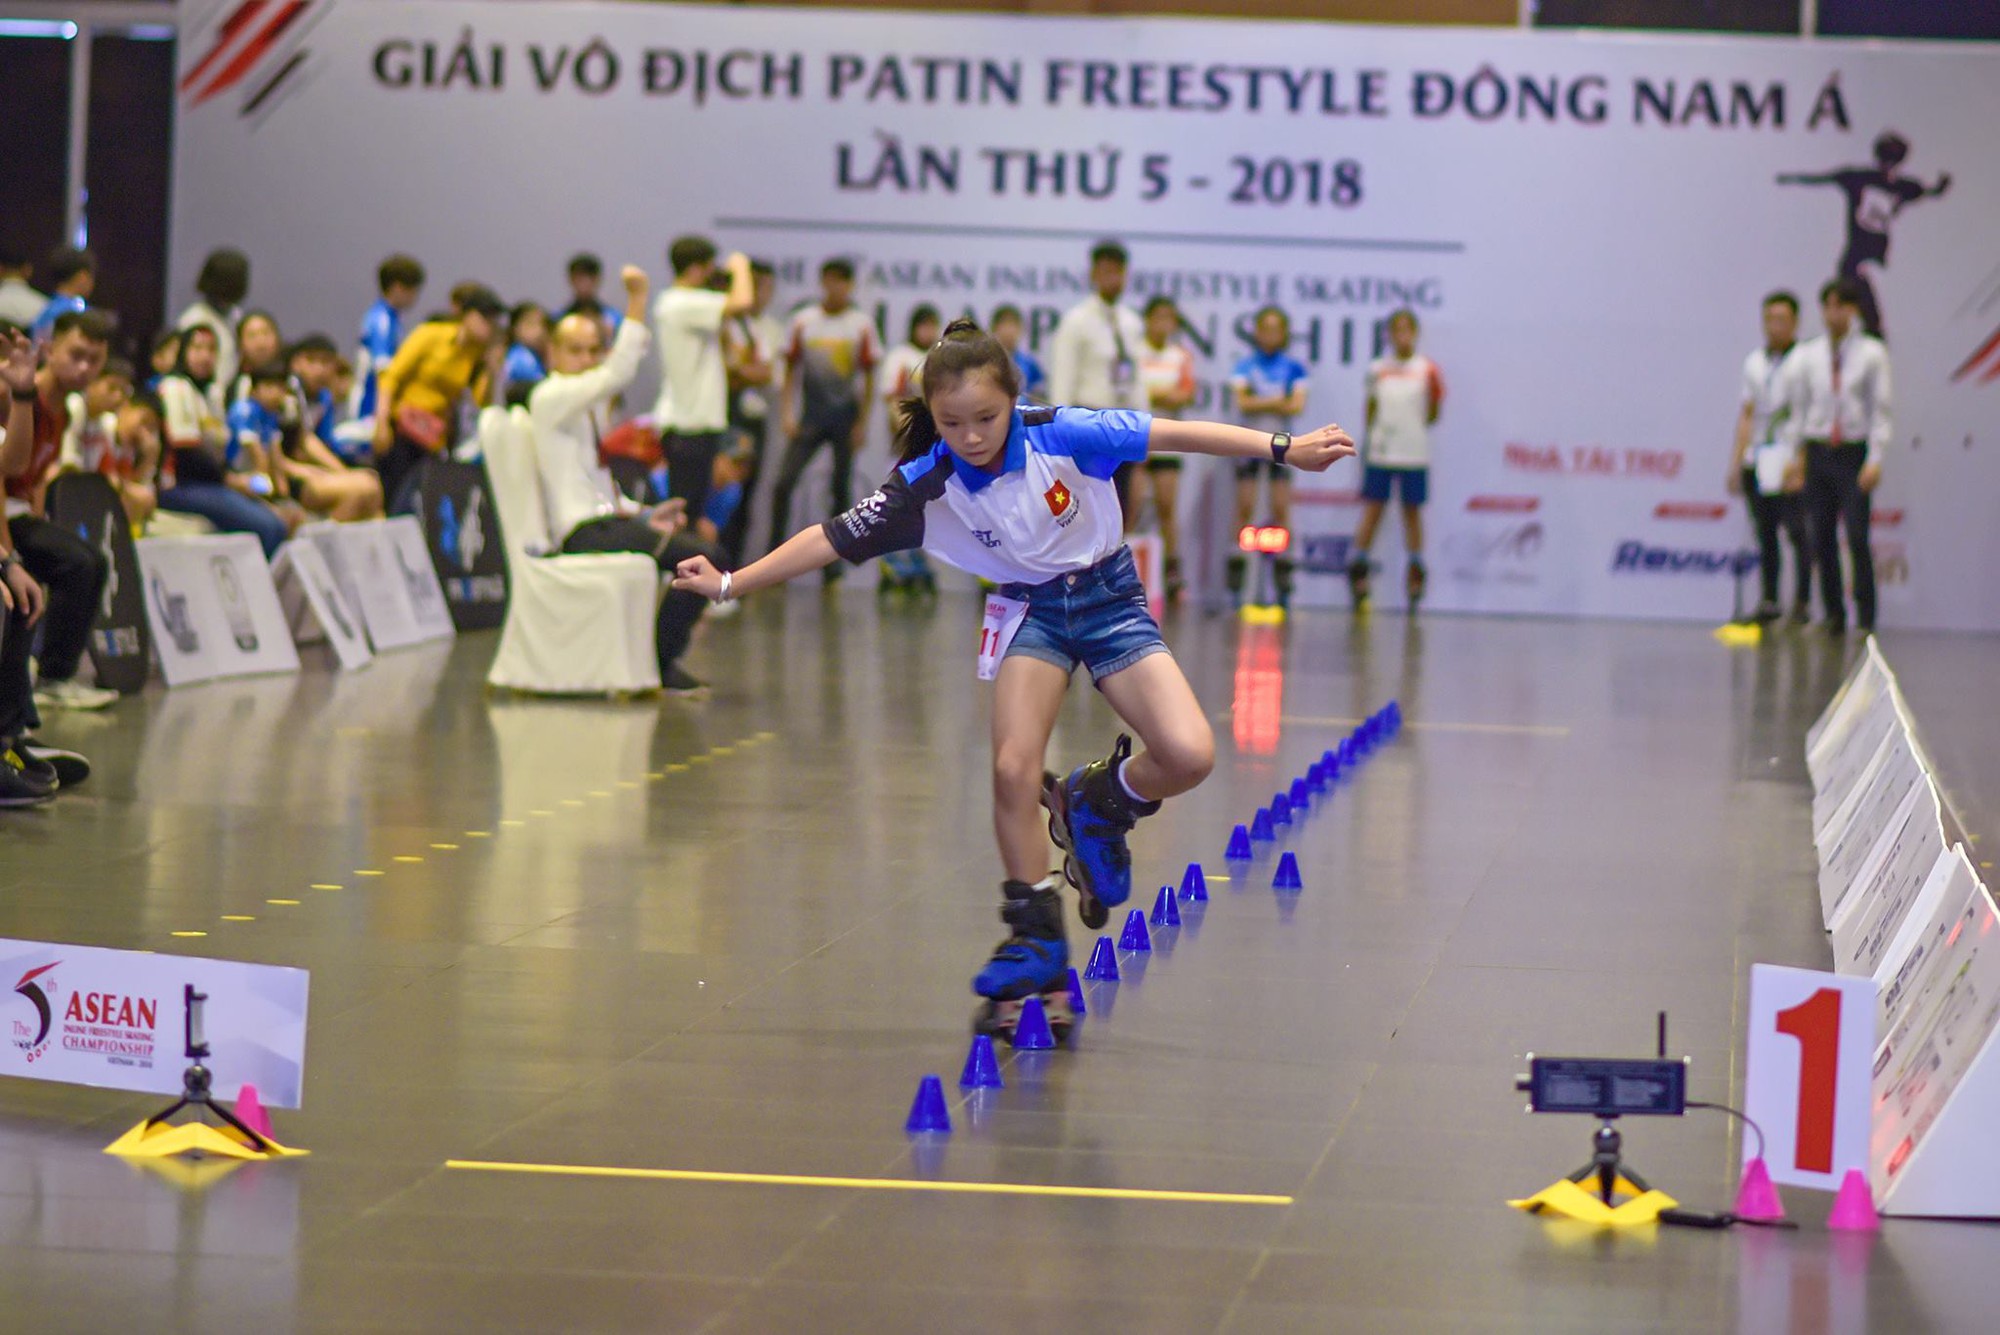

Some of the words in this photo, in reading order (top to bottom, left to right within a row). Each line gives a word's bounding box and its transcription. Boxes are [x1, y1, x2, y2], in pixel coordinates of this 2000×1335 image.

[372, 26, 503, 90] GIẢI
[526, 38, 621, 94] VÔ
[642, 50, 801, 108] ĐỊCH
[828, 54, 1022, 107] PATIN
[1046, 59, 1389, 117] FREESTYLE
[1410, 64, 1607, 124] ĐÔNG
[1632, 77, 1786, 128] NAM
[1805, 72, 1851, 131] Á
[836, 130, 959, 192] LẦN
[978, 144, 1121, 199] THỨ
[1140, 154, 1170, 198] 5
[1229, 156, 1364, 207] 2018
[870, 261, 976, 288] ASEAN
[987, 264, 1087, 292] INLIN
[1130, 270, 1285, 301] REESTYLE
[1295, 275, 1443, 307] SKATING
[979, 627, 1001, 657] 11
[47, 977, 58, 993] th
[13, 1021, 32, 1037] The
[65, 990, 157, 1030] ASEAN
[62, 1035, 155, 1056] CHAMPIONSHIP
[1776, 987, 1842, 1174] 1
